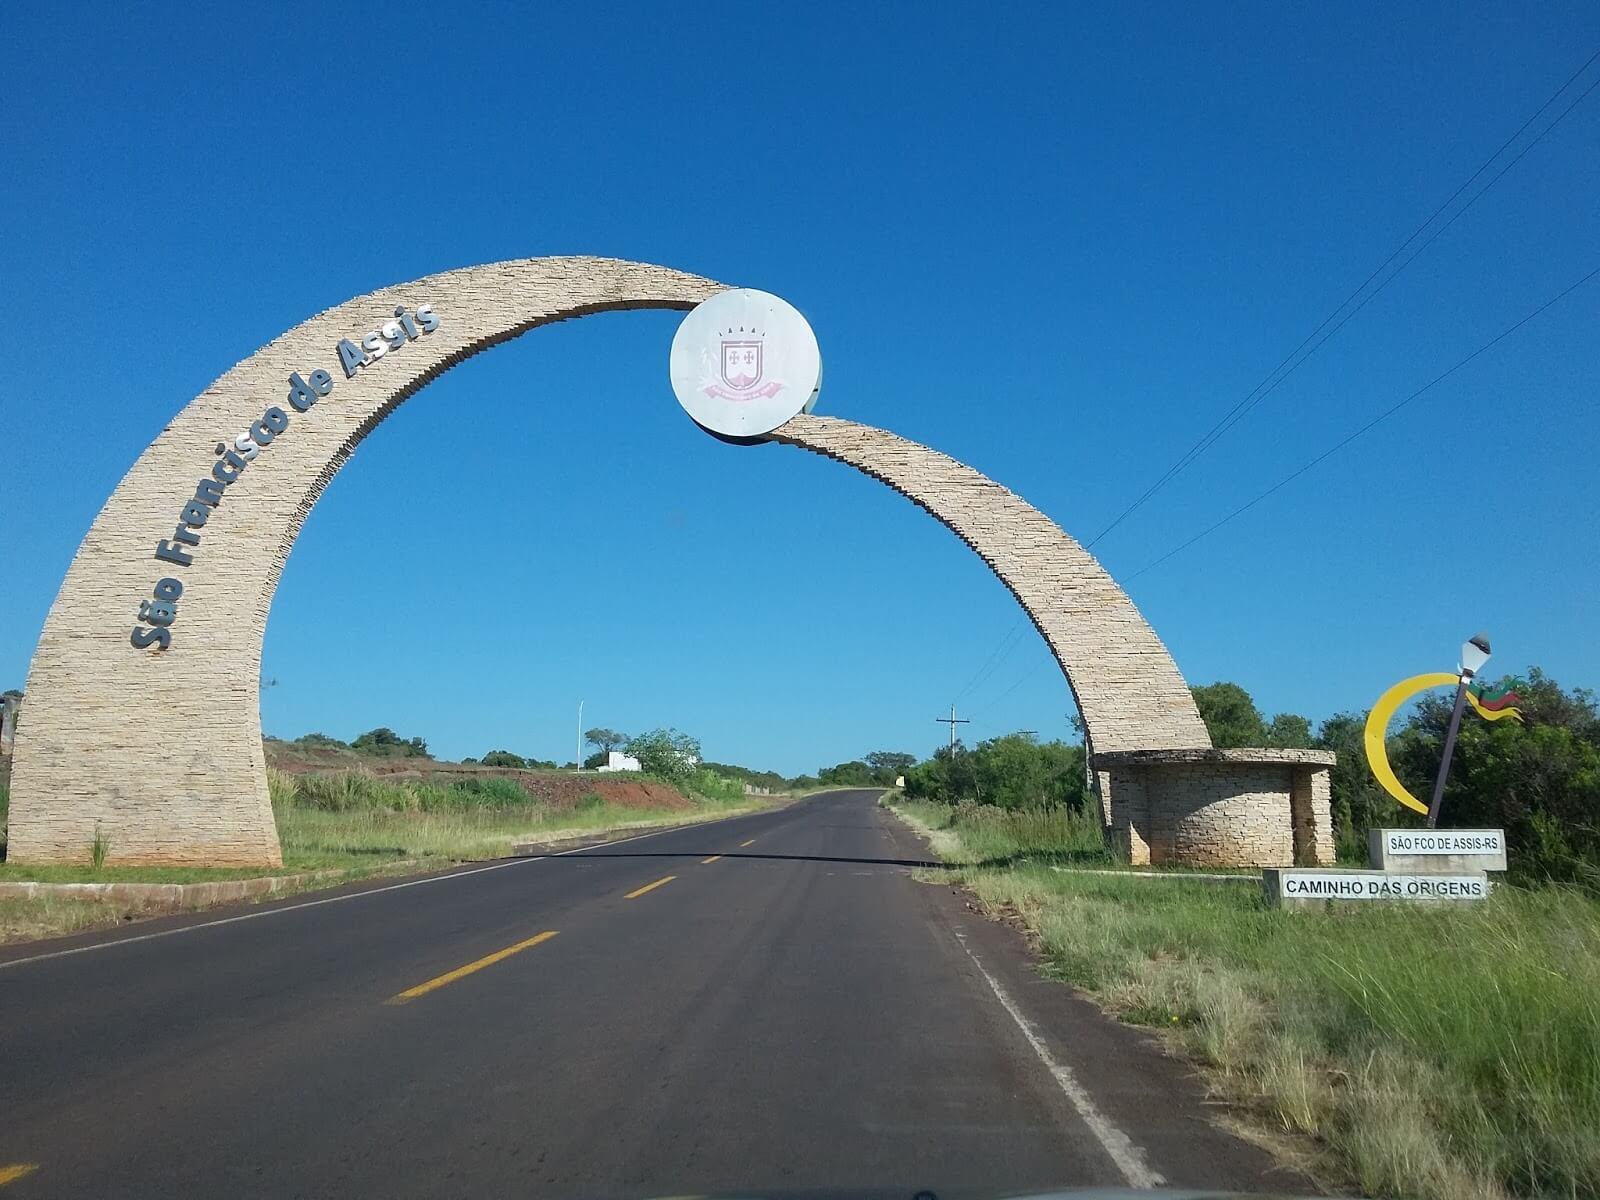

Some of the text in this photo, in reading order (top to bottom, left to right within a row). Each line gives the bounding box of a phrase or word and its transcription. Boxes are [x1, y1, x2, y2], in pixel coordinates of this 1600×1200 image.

[131, 304, 440, 650] São Francisco de Assis
[1391, 835, 1498, 850] SÃO FCO DE ASSIS-RS
[1286, 880, 1481, 896] CAMINHO DAS ORIGENS
